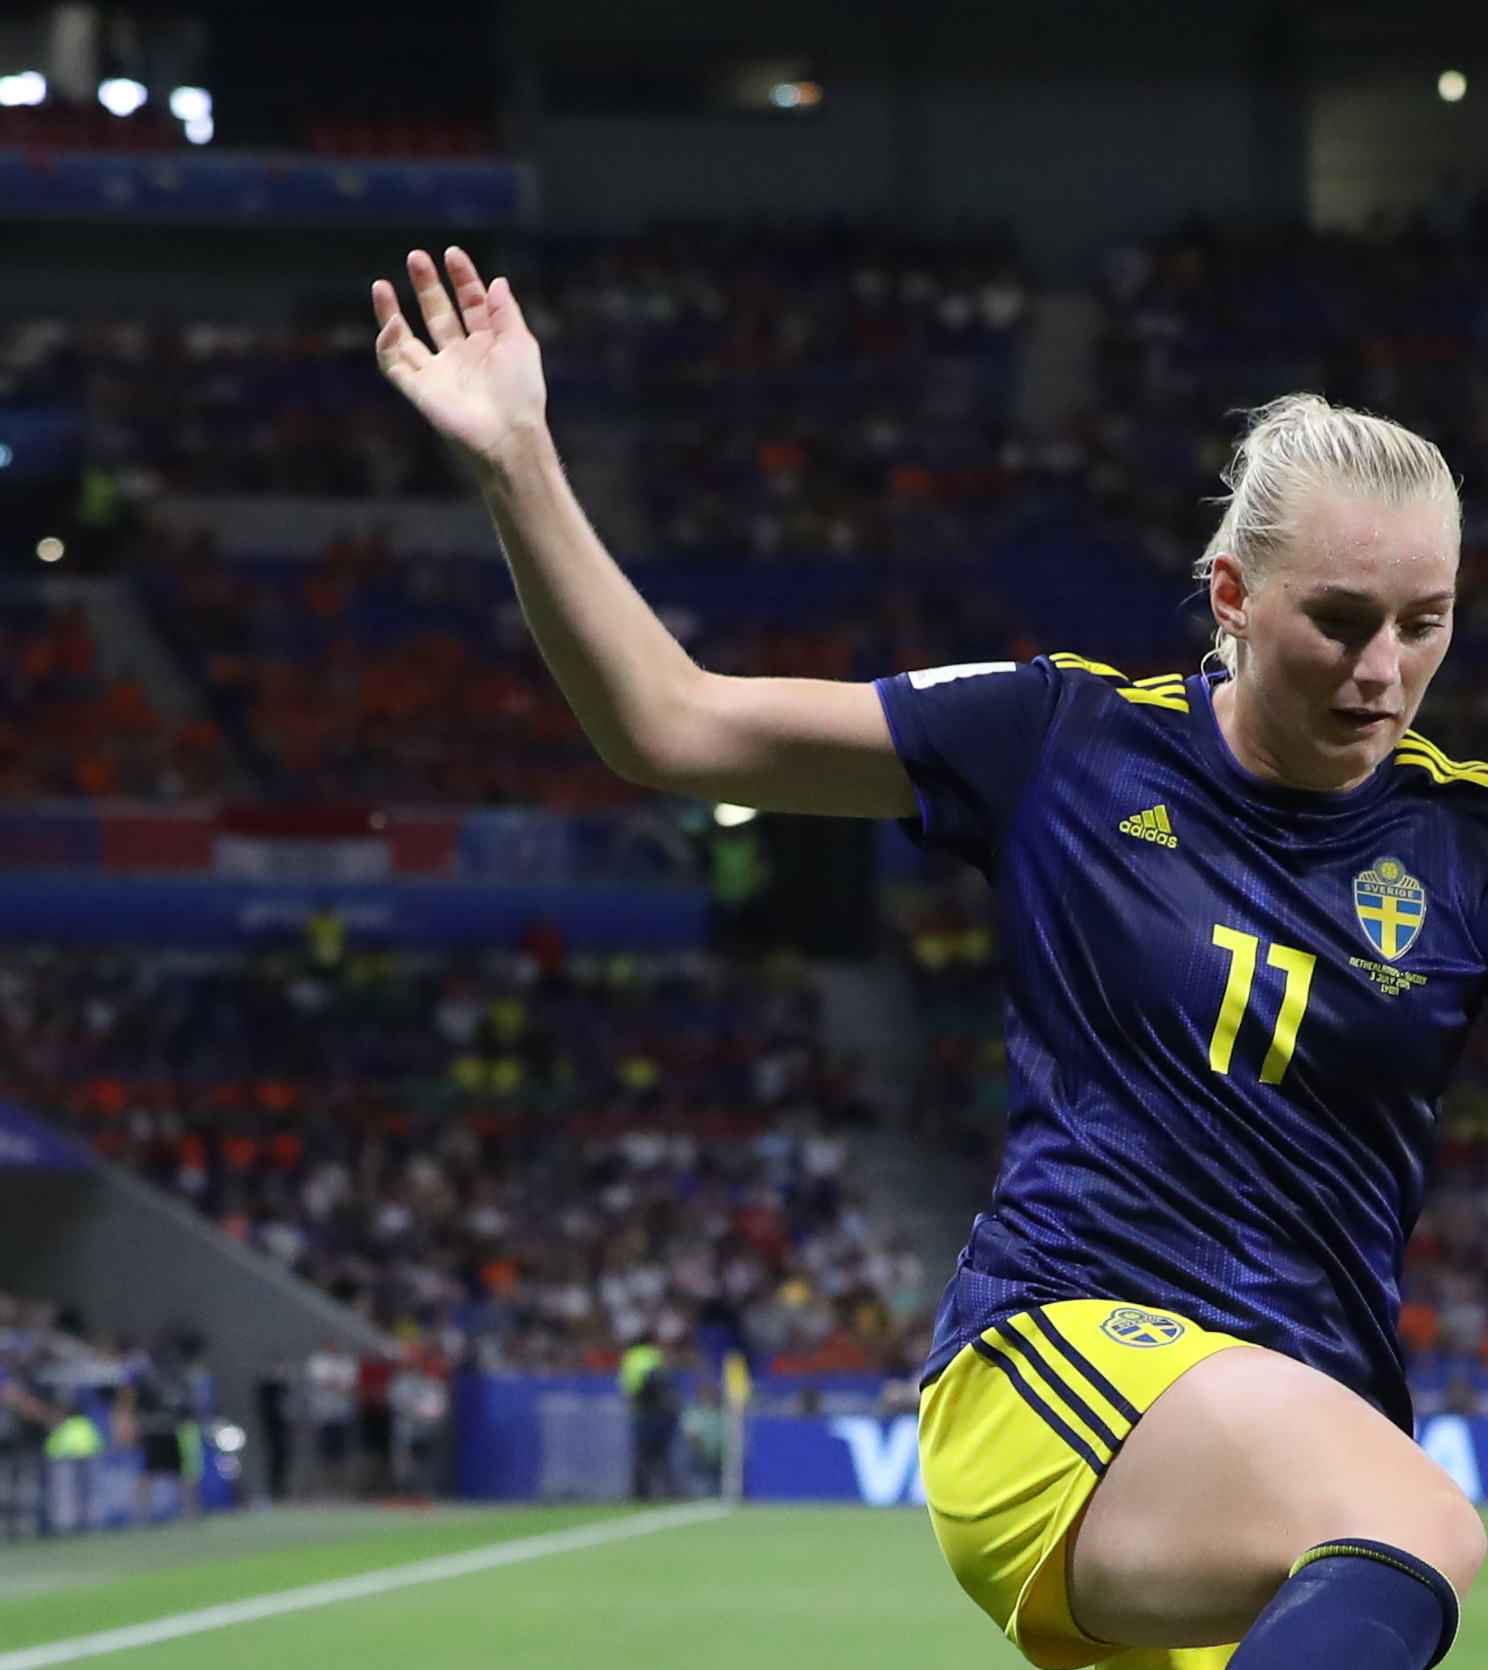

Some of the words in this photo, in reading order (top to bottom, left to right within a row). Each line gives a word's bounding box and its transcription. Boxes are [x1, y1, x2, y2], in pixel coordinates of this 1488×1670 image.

[1119, 821, 1178, 849] adidas
[1364, 884, 1414, 898] SVERIGE
[1209, 924, 1317, 1086] 11
